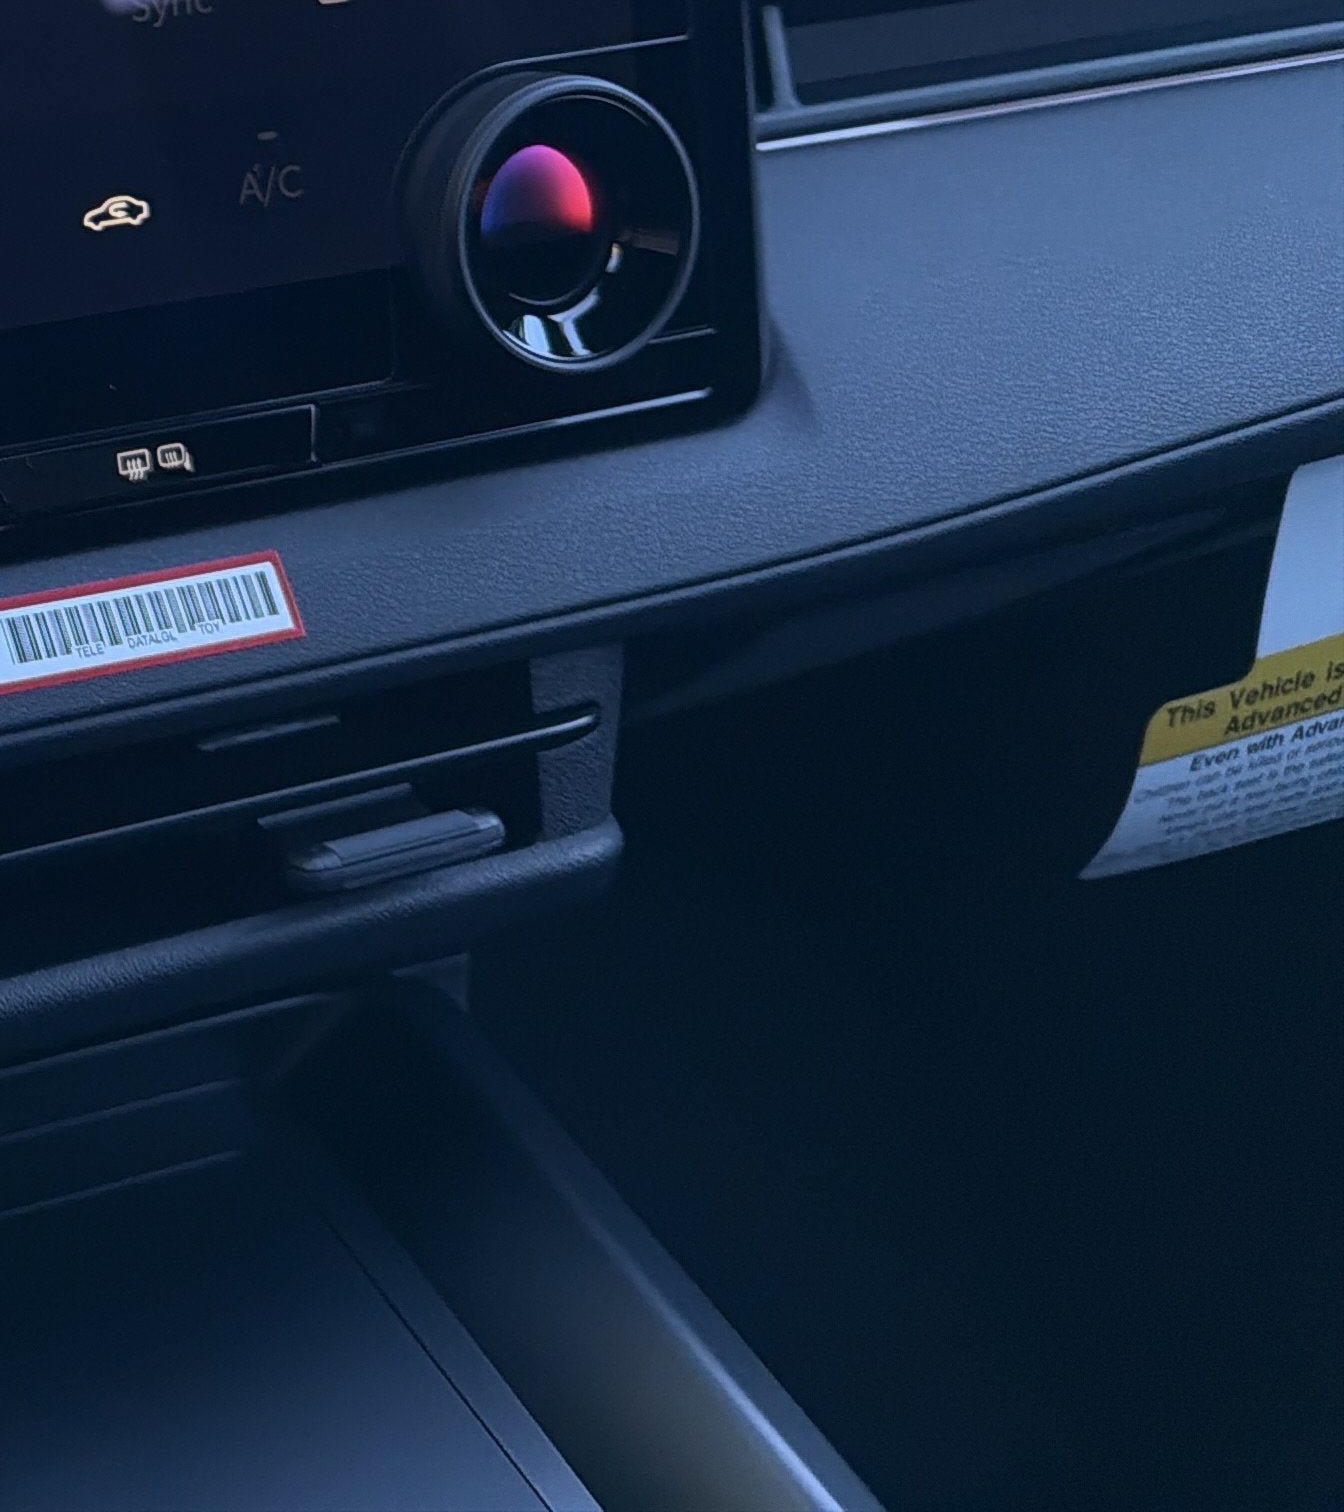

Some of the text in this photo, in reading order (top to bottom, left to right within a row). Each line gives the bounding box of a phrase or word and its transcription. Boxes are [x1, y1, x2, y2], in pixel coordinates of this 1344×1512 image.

[239, 164, 305, 208] A/C
[75, 643, 106, 659] TELE
[1166, 698, 1217, 728] This
[1229, 670, 1316, 710] Vehicle
[1223, 686, 1342, 736] Advanced
[1189, 746, 1240, 773] Even
[1246, 734, 1285, 756] with
